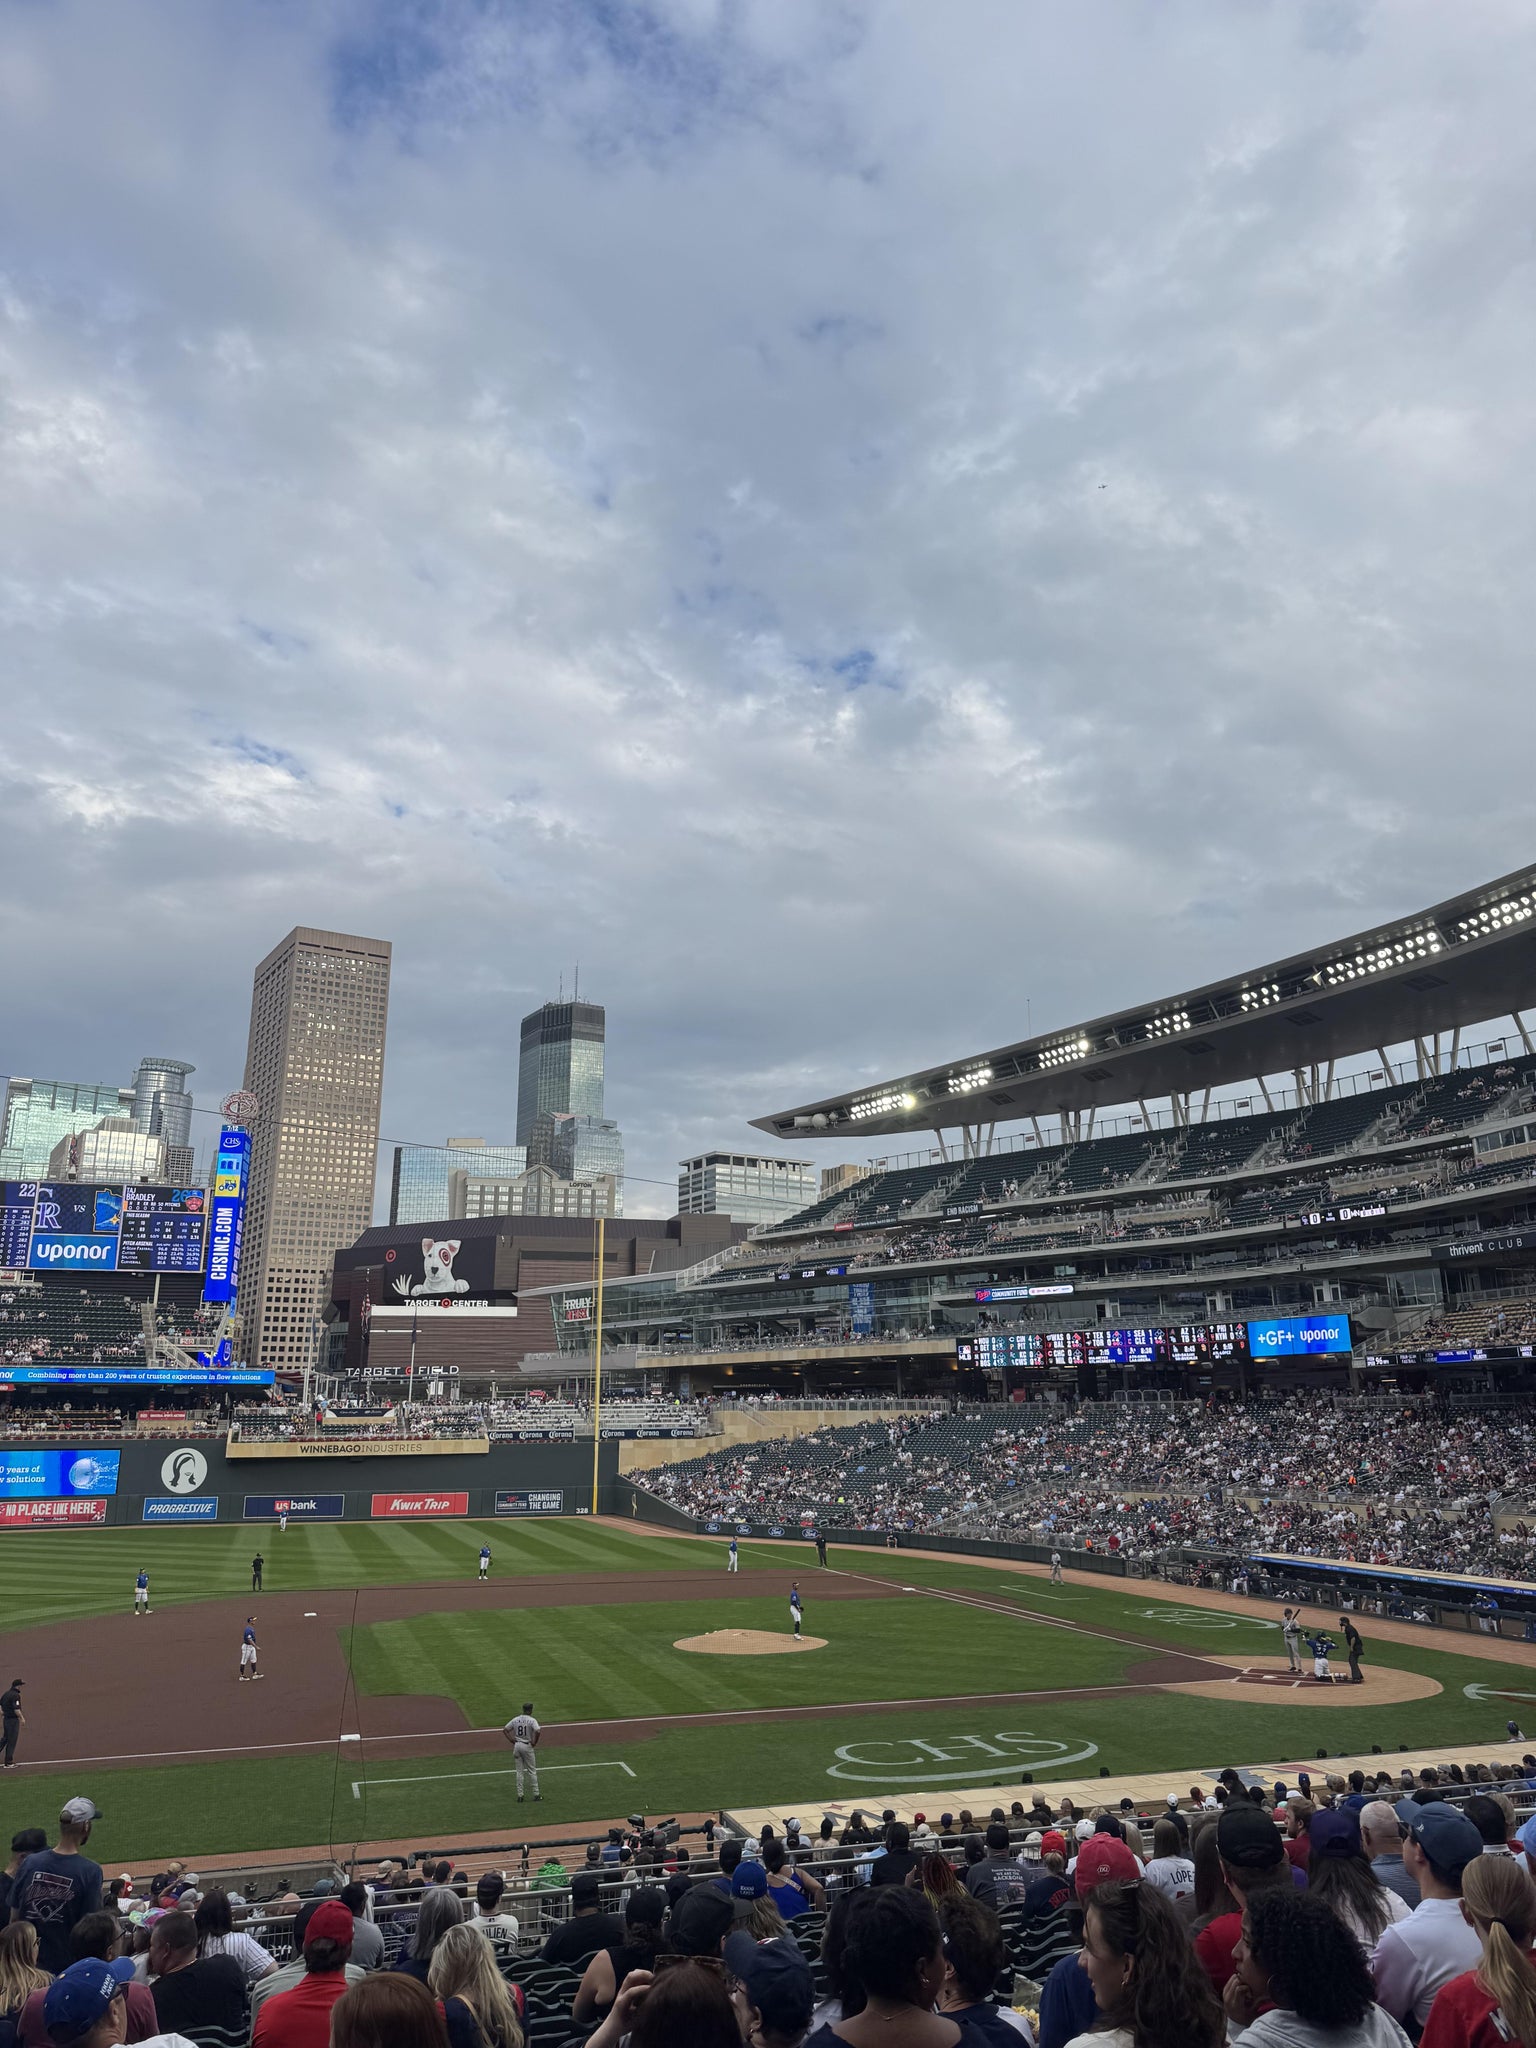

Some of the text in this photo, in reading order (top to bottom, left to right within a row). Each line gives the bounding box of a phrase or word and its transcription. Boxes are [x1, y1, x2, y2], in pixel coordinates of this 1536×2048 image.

[19, 1184, 36, 1196] 22
[946, 1204, 979, 1216] END RACISM
[210, 1208, 233, 1280] CHSINC.COM
[1450, 1238, 1522, 1256] thrivent CLUB
[37, 1244, 111, 1262] uponor
[565, 1297, 592, 1310] TRULY
[1216, 1324, 1226, 1332] PHI
[1300, 1328, 1340, 1344] uponor
[28, 1372, 67, 1380] Combining
[345, 1366, 460, 1376] TARGET FIELD
[490, 1432, 513, 1440] Corona
[519, 1431, 542, 1440] Corona
[548, 1430, 572, 1439] Corona
[602, 1429, 625, 1438] Corona
[636, 1429, 660, 1438] Corona
[670, 1428, 694, 1438] Corona
[300, 1444, 422, 1454] WINNEBAGO INDUSTRIES
[6, 1466, 30, 1474] years
[528, 1494, 560, 1502] CHANGING
[6, 1504, 16, 1516] NO
[18, 1503, 52, 1516] PLACE
[52, 1502, 68, 1514] LIKE
[148, 1504, 214, 1514] PROGRESSIVE
[276, 1500, 316, 1510] us bank
[542, 1502, 560, 1510] GAME
[518, 1726, 526, 1736] 81
[834, 1731, 1069, 1766] CHS
